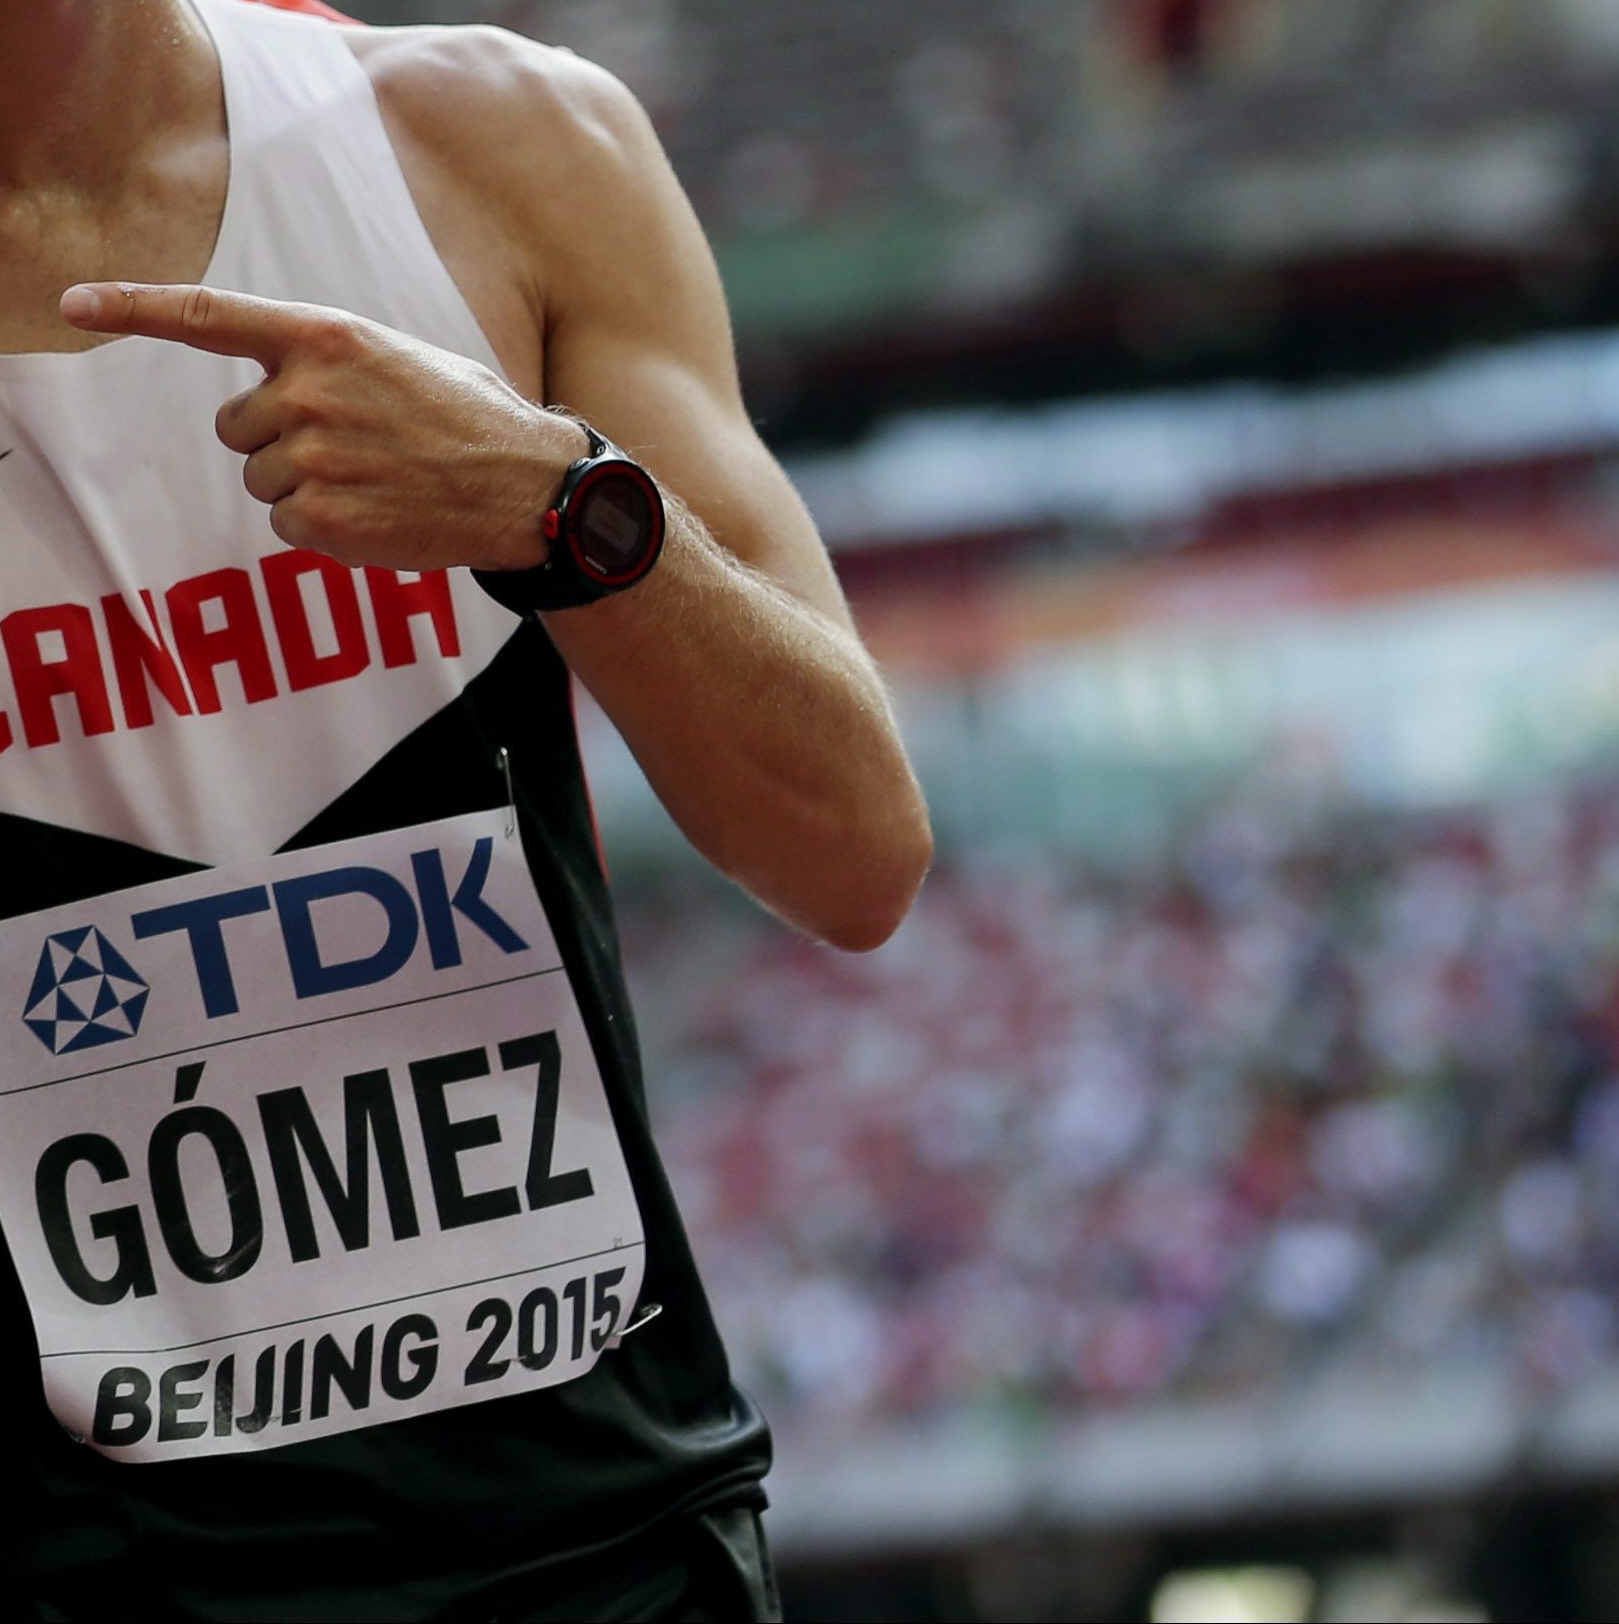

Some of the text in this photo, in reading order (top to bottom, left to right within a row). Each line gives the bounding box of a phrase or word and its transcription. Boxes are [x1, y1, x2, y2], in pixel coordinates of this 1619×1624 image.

[130, 836, 530, 1019] TDK
[34, 1029, 596, 1306] GÓMEZ
[92, 1266, 627, 1447] BEIJING 2015
